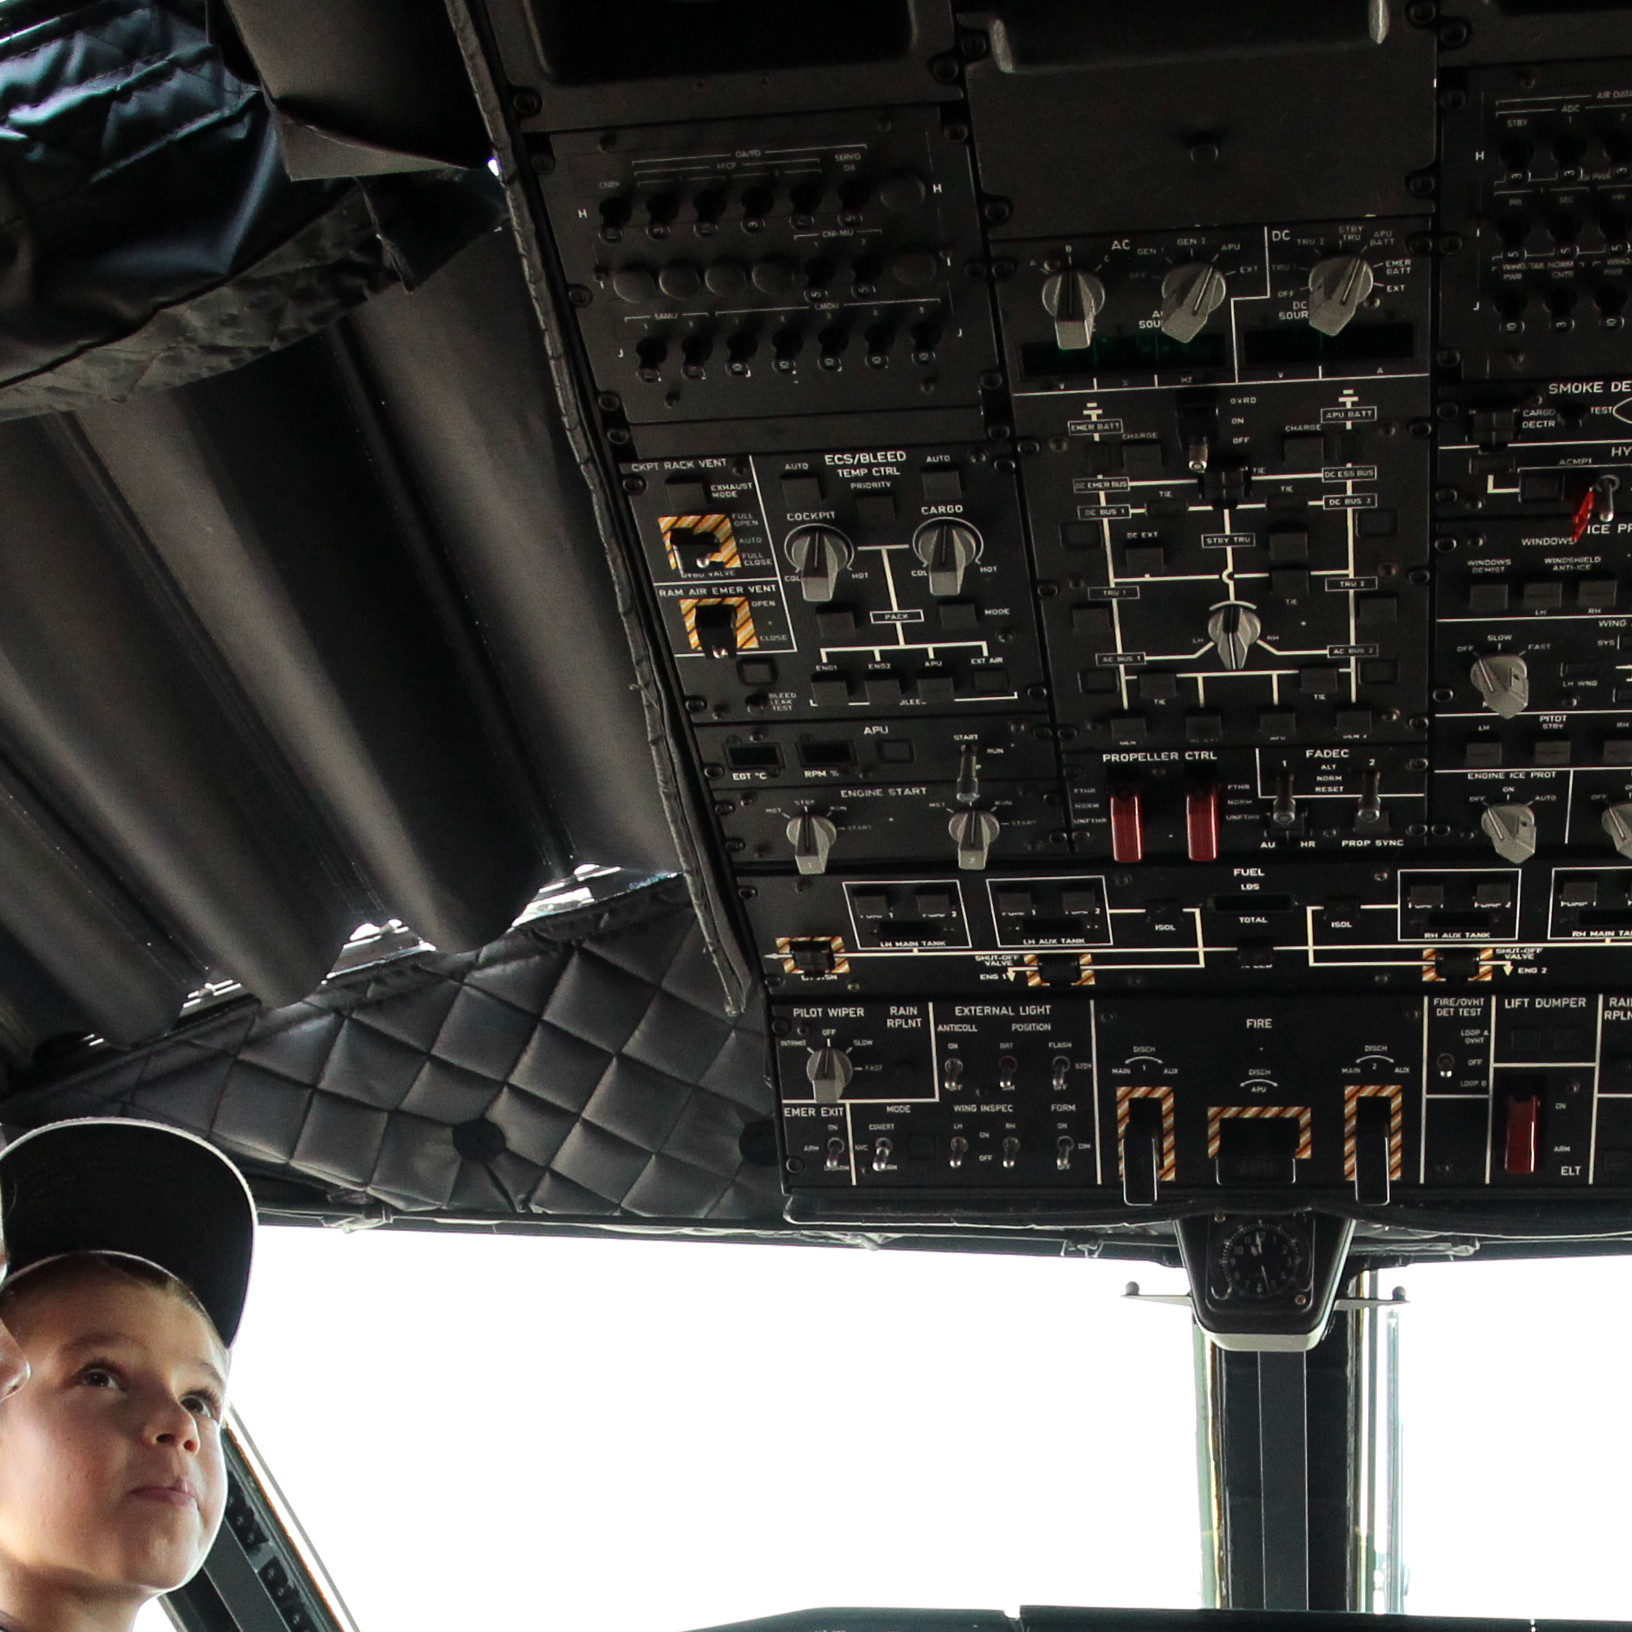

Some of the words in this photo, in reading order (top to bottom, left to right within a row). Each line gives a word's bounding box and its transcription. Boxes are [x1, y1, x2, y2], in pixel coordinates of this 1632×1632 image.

[1271, 230, 1291, 241] DC
[1385, 259, 1411, 268] EMER
[1385, 266, 1411, 275] BATT
[1548, 380, 1604, 394] SMOKE
[1349, 410, 1373, 418] BATT
[1522, 407, 1556, 417] CARGO
[1589, 406, 1613, 415] TEST
[1522, 419, 1556, 429] DECTR
[824, 451, 907, 466] ECS/BLEED
[925, 454, 951, 463] AUTO
[631, 461, 660, 472] CKPT
[663, 460, 693, 471] RACK
[698, 458, 727, 469] VENT
[784, 462, 809, 471] AUTO
[836, 467, 868, 478] TEMP
[872, 466, 901, 477] CTRL
[850, 480, 892, 490] PRIORITY
[920, 504, 964, 515] CARGO
[786, 511, 836, 522] COCKPIT
[1586, 521, 1612, 534] ICE
[1521, 536, 1575, 547] WINDOWS
[658, 587, 683, 598] RAM
[688, 586, 707, 596] AIR
[711, 585, 740, 596] EMER
[745, 584, 777, 594] VENT
[984, 608, 1010, 616] MODE
[1598, 618, 1627, 628] WING
[1487, 633, 1513, 642] SLOW
[1527, 642, 1551, 651] FAST
[1539, 715, 1567, 723] PITOT
[864, 725, 889, 736] APU
[1102, 752, 1180, 763] PROPELLER
[1185, 751, 1218, 761] CTRL
[1306, 748, 1350, 759] FADEC
[1321, 763, 1337, 771] ALT
[1468, 771, 1506, 780] ENGINE
[1510, 771, 1527, 779] ICE
[1531, 770, 1557, 779] PROT
[840, 788, 884, 798] ENGINE
[888, 786, 927, 797] START
[1341, 839, 1371, 847] PROP
[1374, 839, 1404, 847] SYNC
[1233, 868, 1265, 877] FUEL
[1241, 883, 1260, 891] LBS
[1239, 916, 1268, 924] TOTAL
[1464, 931, 1491, 939] TANK
[1590, 930, 1615, 938] MAIN
[1060, 937, 1086, 945] TANK
[1517, 967, 1538, 975] ENG
[1504, 998, 1530, 1009] LIFT
[1535, 997, 1587, 1009] DUMPER
[793, 1008, 824, 1018] PILOT
[829, 1007, 865, 1018] WIPER
[889, 1005, 918, 1015] RAIN
[954, 1005, 1015, 1016] EXTERNAL
[1019, 1005, 1051, 1016] LIGHT
[1436, 1008, 1454, 1017] DET
[1458, 1007, 1481, 1017] TEST
[886, 1018, 922, 1029] RPLNT
[937, 1024, 978, 1033] ANTICOLL
[1012, 1023, 1051, 1032] POSITION
[1246, 1018, 1273, 1029] FIRE
[784, 1107, 817, 1117] EMER
[820, 1107, 844, 1118] EXIT
[886, 1105, 911, 1113] MODE
[953, 1104, 977, 1113] WING
[980, 1104, 1014, 1113] INSPEC
[1051, 1103, 1076, 1112] FORM
[1561, 1166, 1582, 1176] ELT
